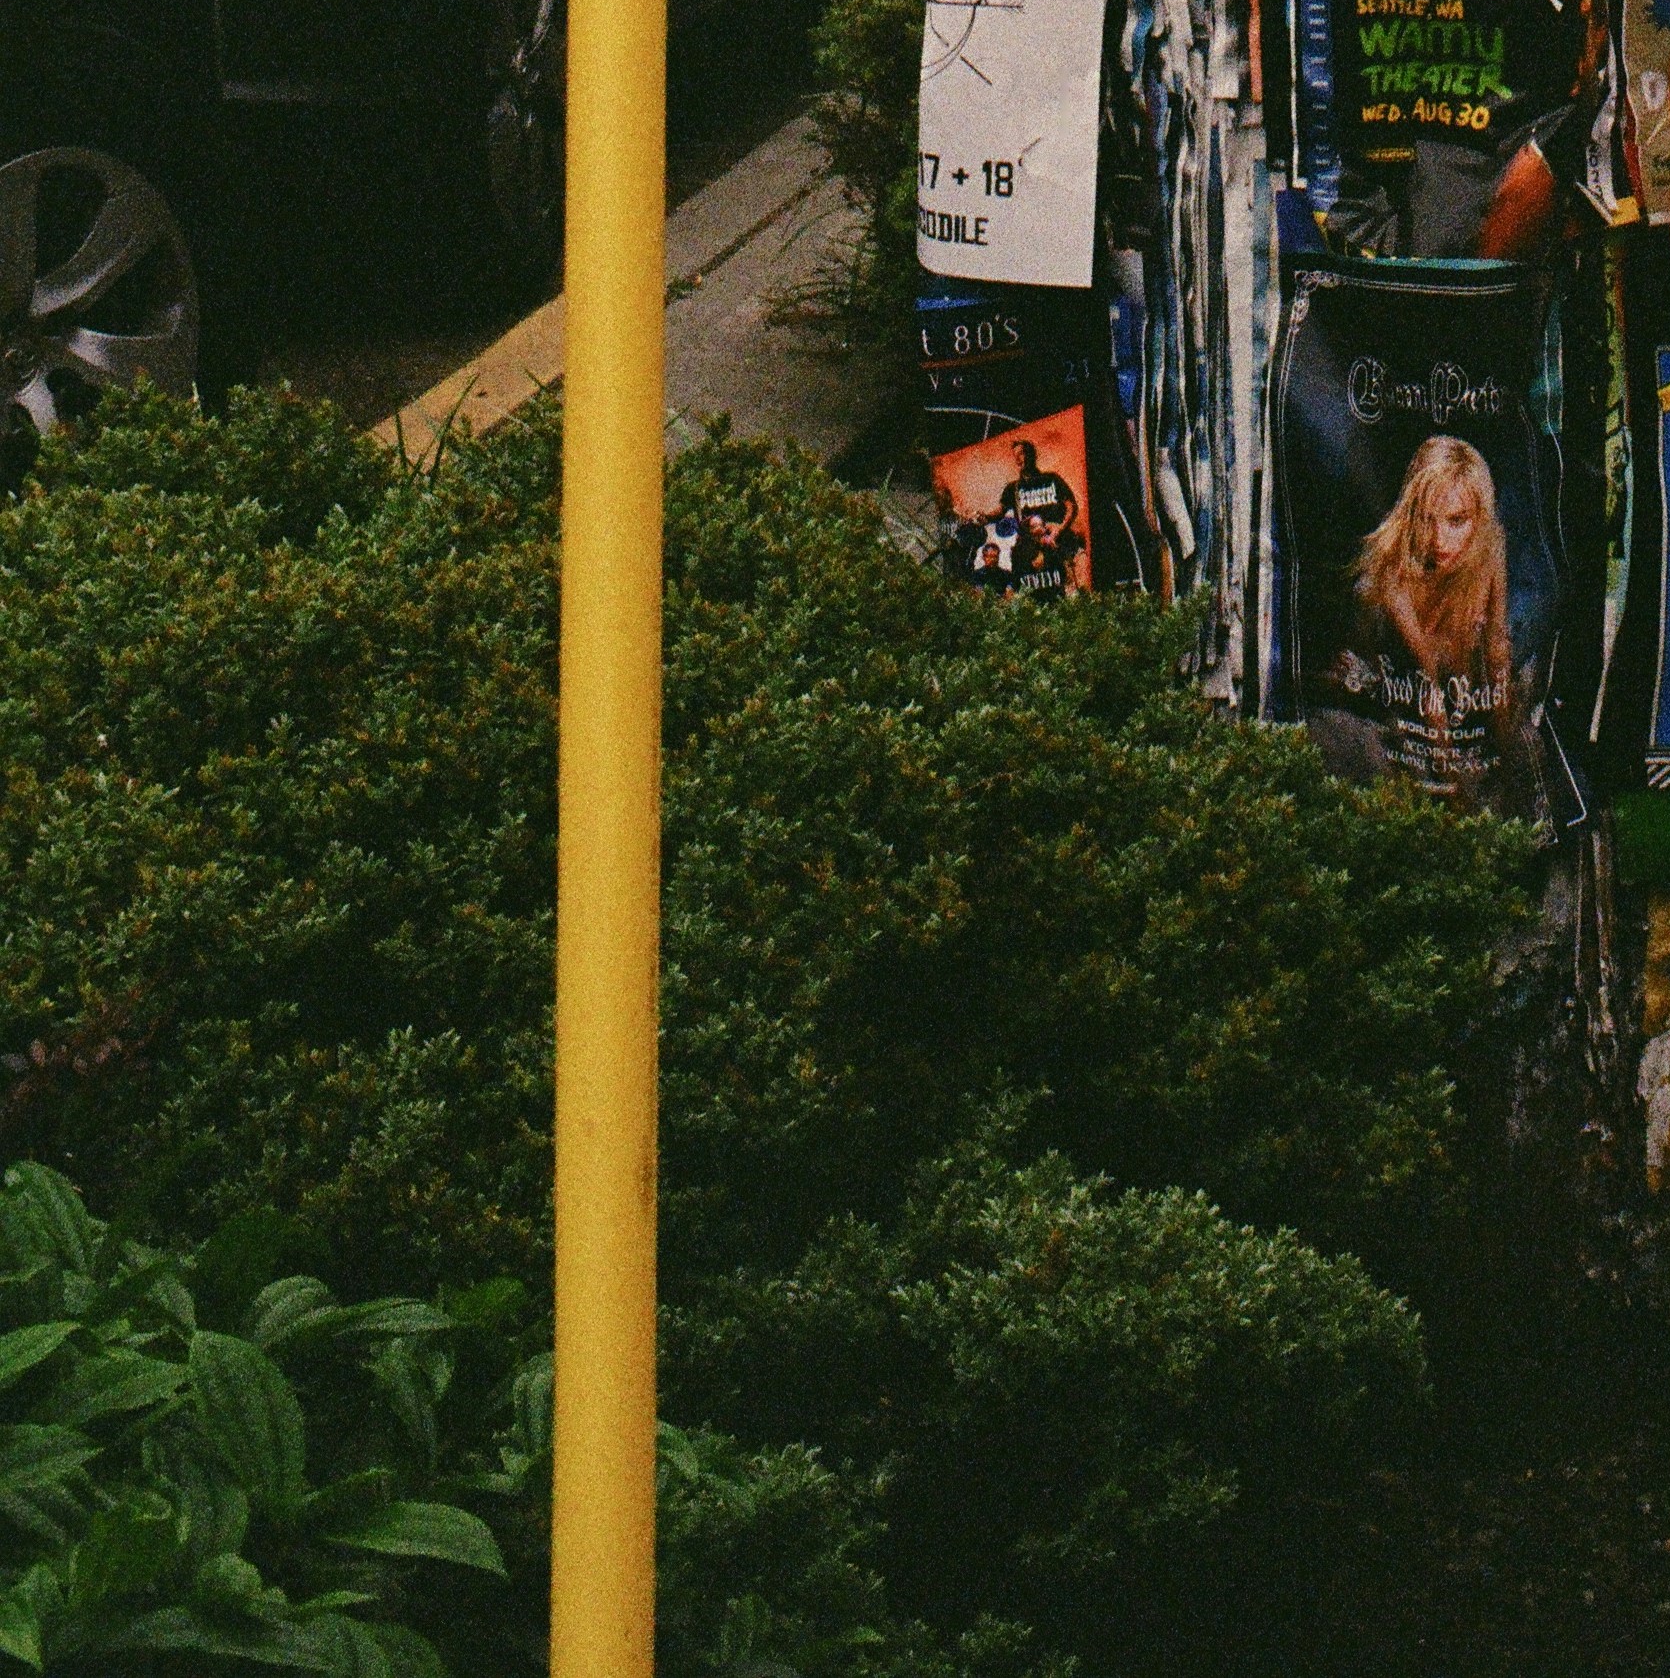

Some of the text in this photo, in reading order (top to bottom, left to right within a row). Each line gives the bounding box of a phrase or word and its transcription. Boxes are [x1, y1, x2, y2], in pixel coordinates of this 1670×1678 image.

[1358, 19, 1504, 61] WAMU
[1359, 62, 1514, 101] THEATER
[1413, 98, 1452, 126] AUG
[1455, 101, 1491, 131] 30
[981, 160, 1014, 198] 18
[1443, 727, 1487, 742] TOUR
